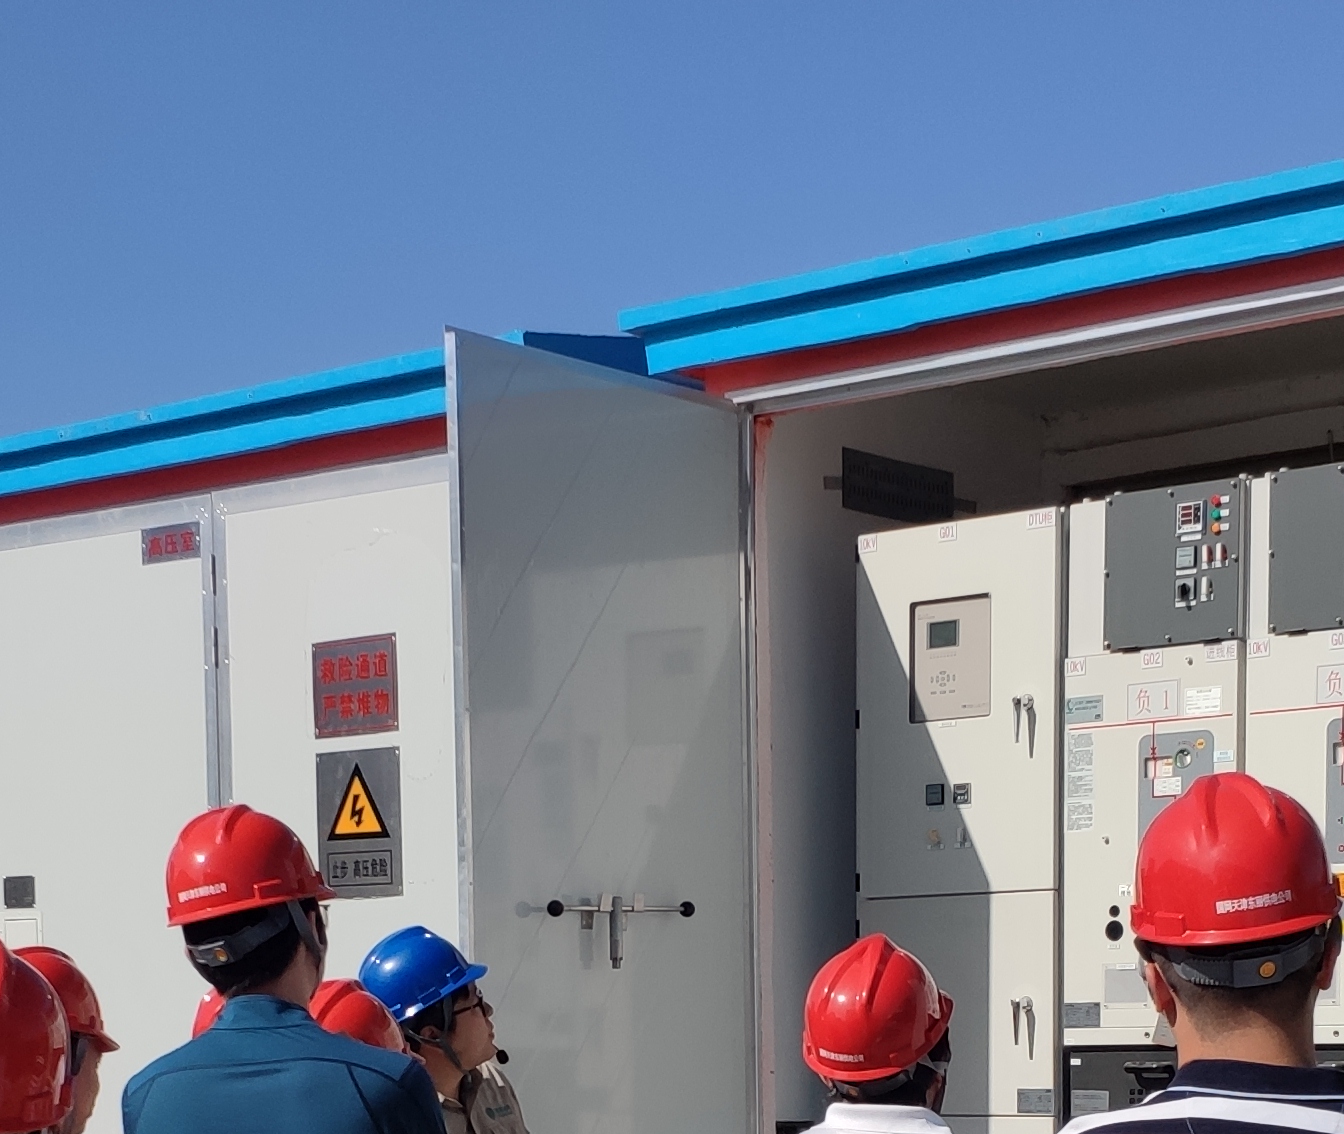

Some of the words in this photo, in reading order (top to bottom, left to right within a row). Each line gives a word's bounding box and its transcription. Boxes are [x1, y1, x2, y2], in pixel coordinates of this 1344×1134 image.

[940, 526, 954, 538] G01
[148, 531, 194, 558] 高压室
[860, 538, 875, 551] 10kV
[1248, 640, 1269, 656] 10kV
[1066, 660, 1085, 674] 10kV
[1143, 652, 1160, 666] G02
[321, 650, 388, 685] 救险通道
[1325, 669, 1343, 699] 负
[1135, 688, 1151, 716] 负
